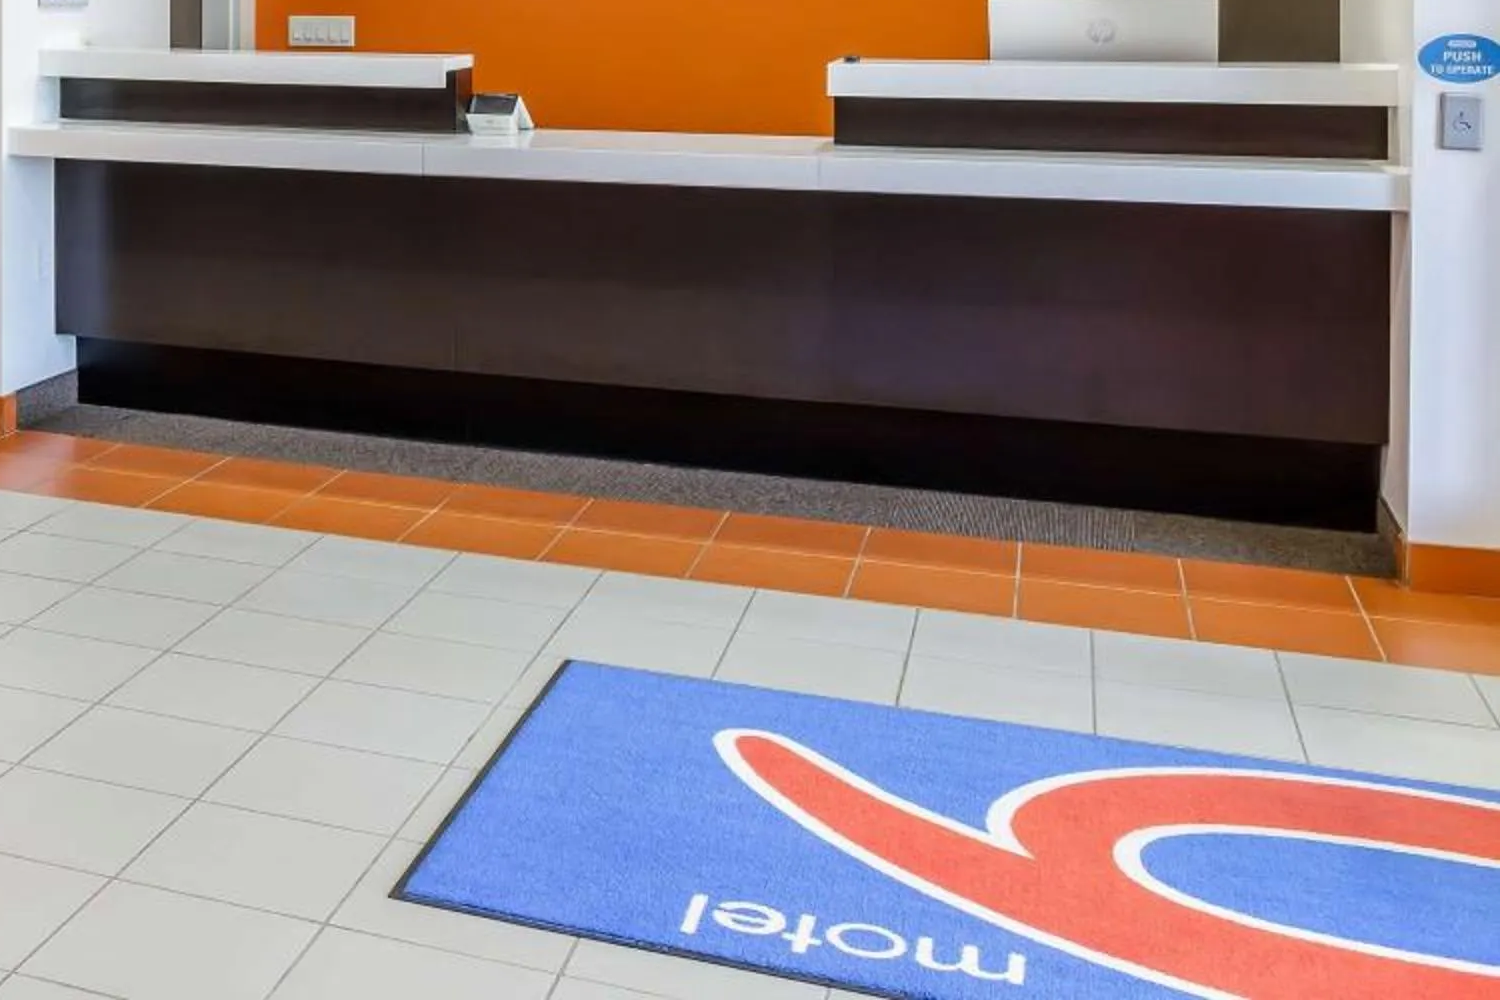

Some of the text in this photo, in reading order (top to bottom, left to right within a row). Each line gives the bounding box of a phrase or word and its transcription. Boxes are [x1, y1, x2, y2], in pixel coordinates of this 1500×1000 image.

[1443, 51, 1483, 63] PUSH
[1431, 64, 1445, 75] TO
[679, 894, 1026, 985] motel
